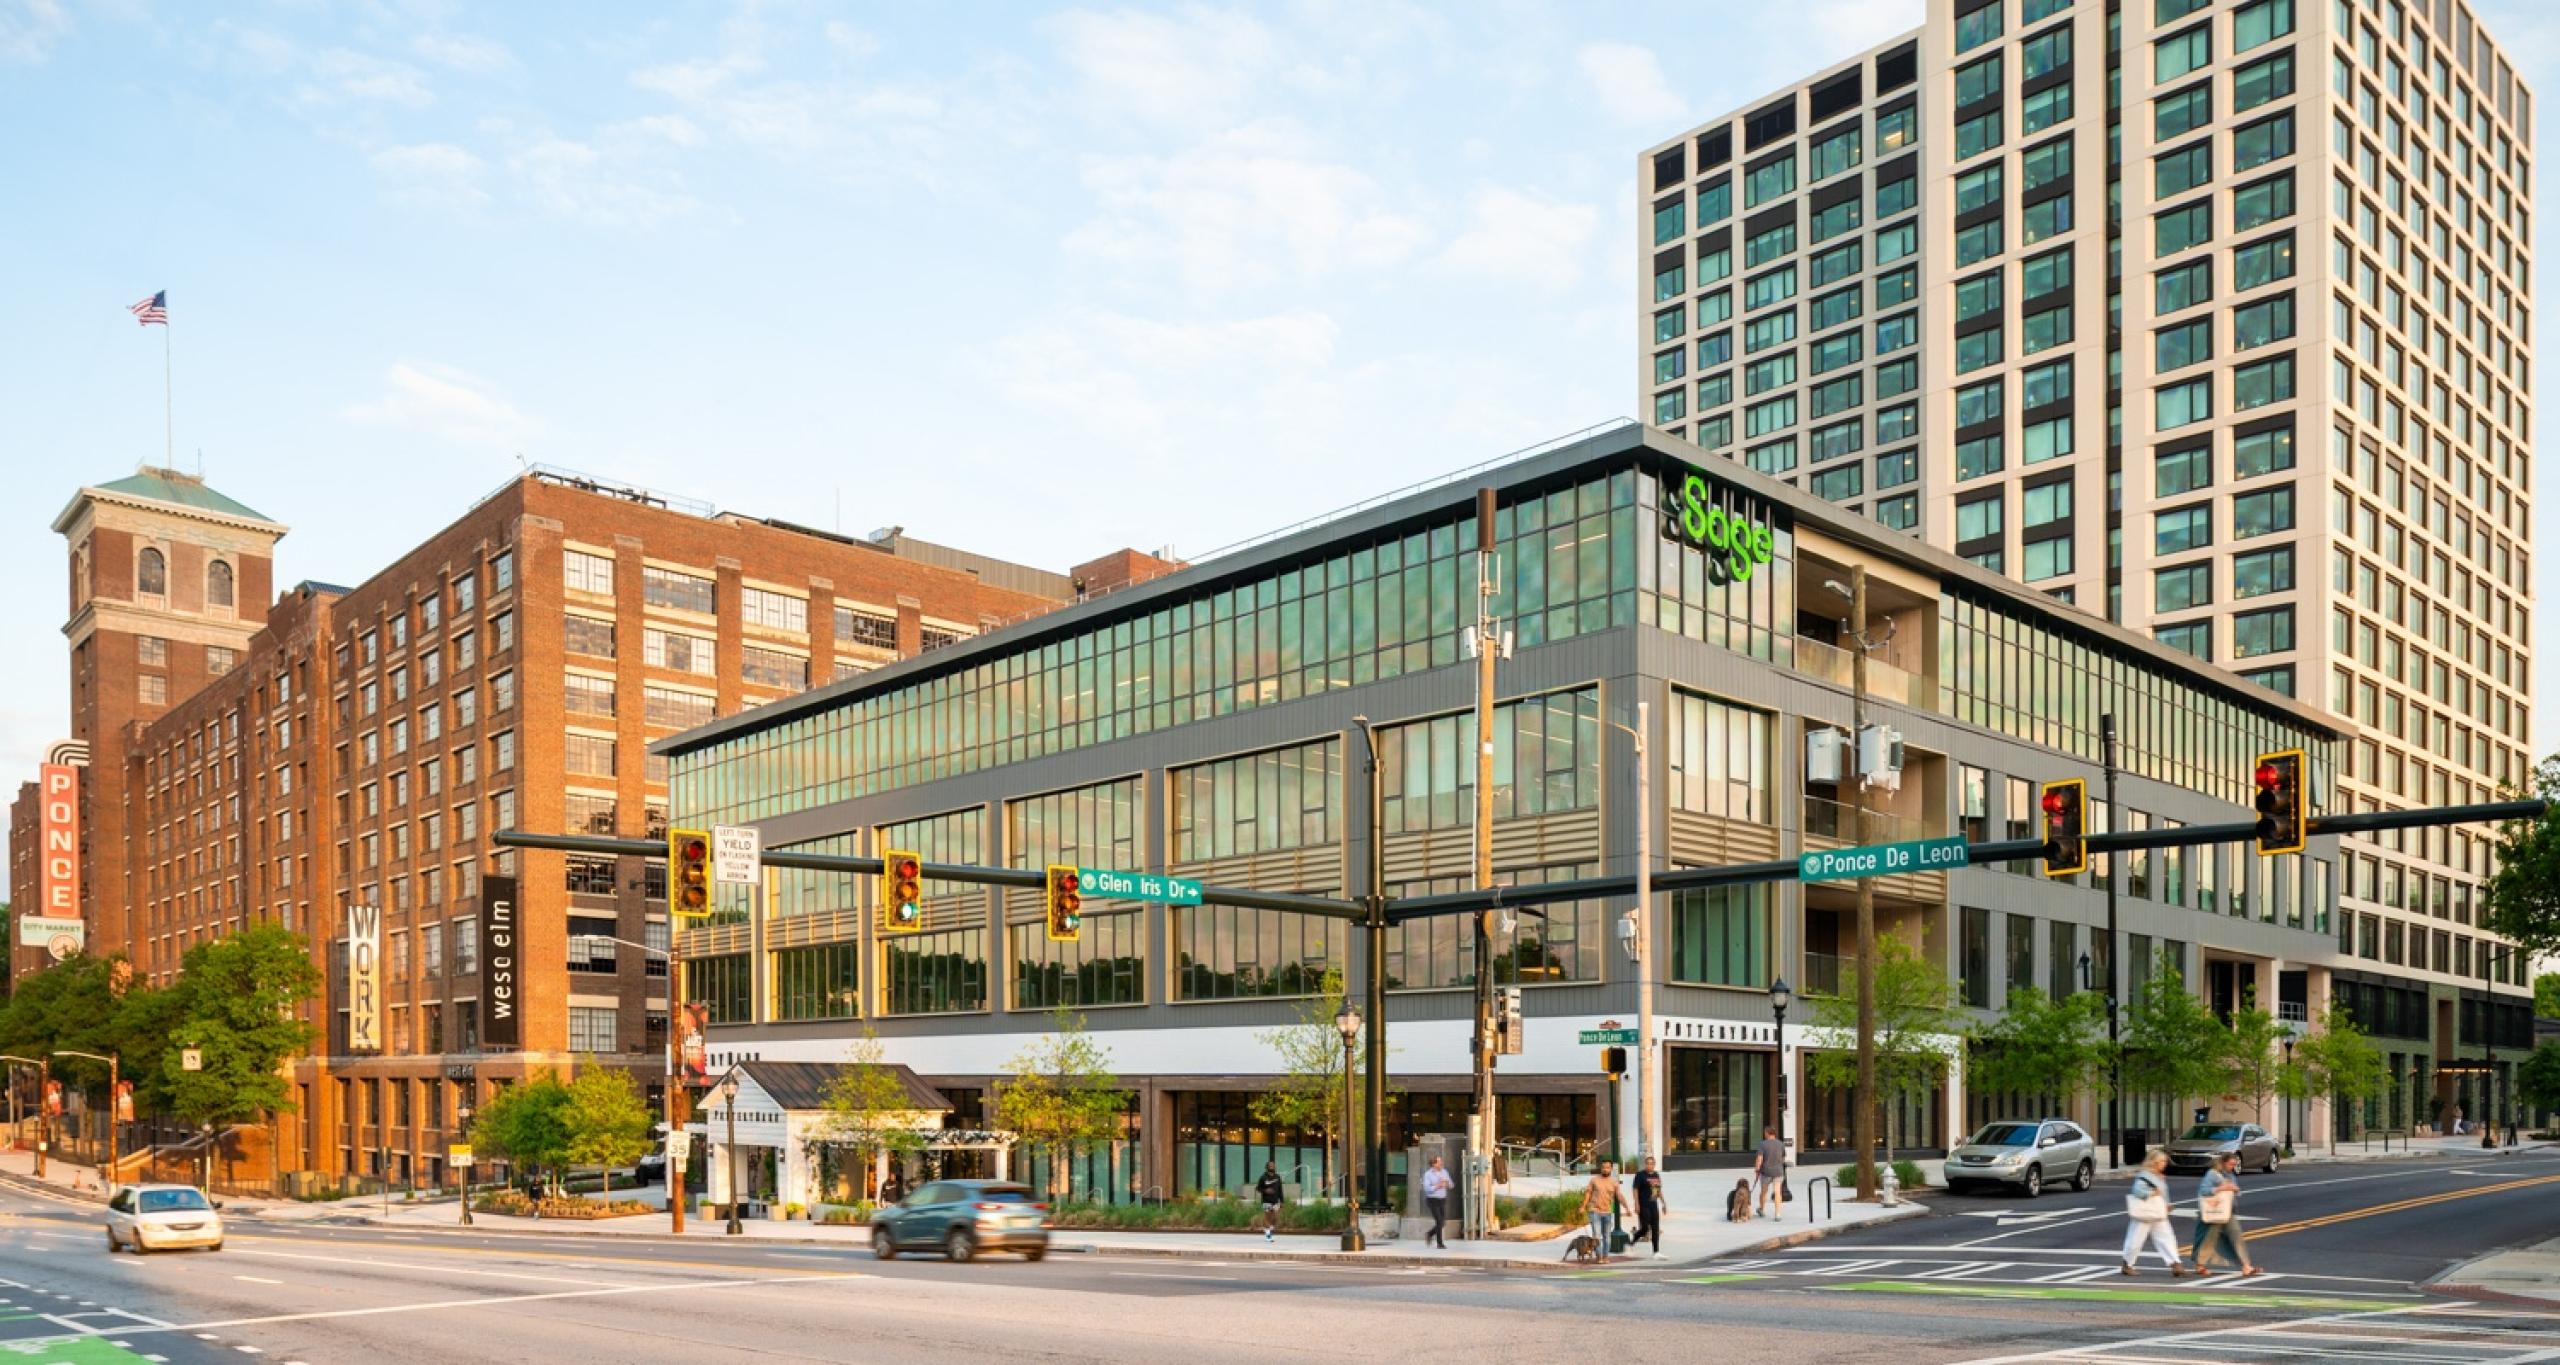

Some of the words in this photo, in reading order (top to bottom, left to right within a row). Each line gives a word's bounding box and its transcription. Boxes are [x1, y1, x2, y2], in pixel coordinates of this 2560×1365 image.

[50, 773, 73, 908] PONCE
[723, 840, 752, 850] YIELD
[1823, 854, 1877, 874] Ponce
[1886, 847, 1909, 868] De
[1920, 844, 1964, 864] Leon
[1099, 873, 1132, 893] Glen
[1141, 877, 1161, 896] Iris
[1168, 880, 1185, 898] Dr
[489, 900, 511, 948] elm
[352, 906, 377, 1040] WORK
[671, 1144, 687, 1155] 35
